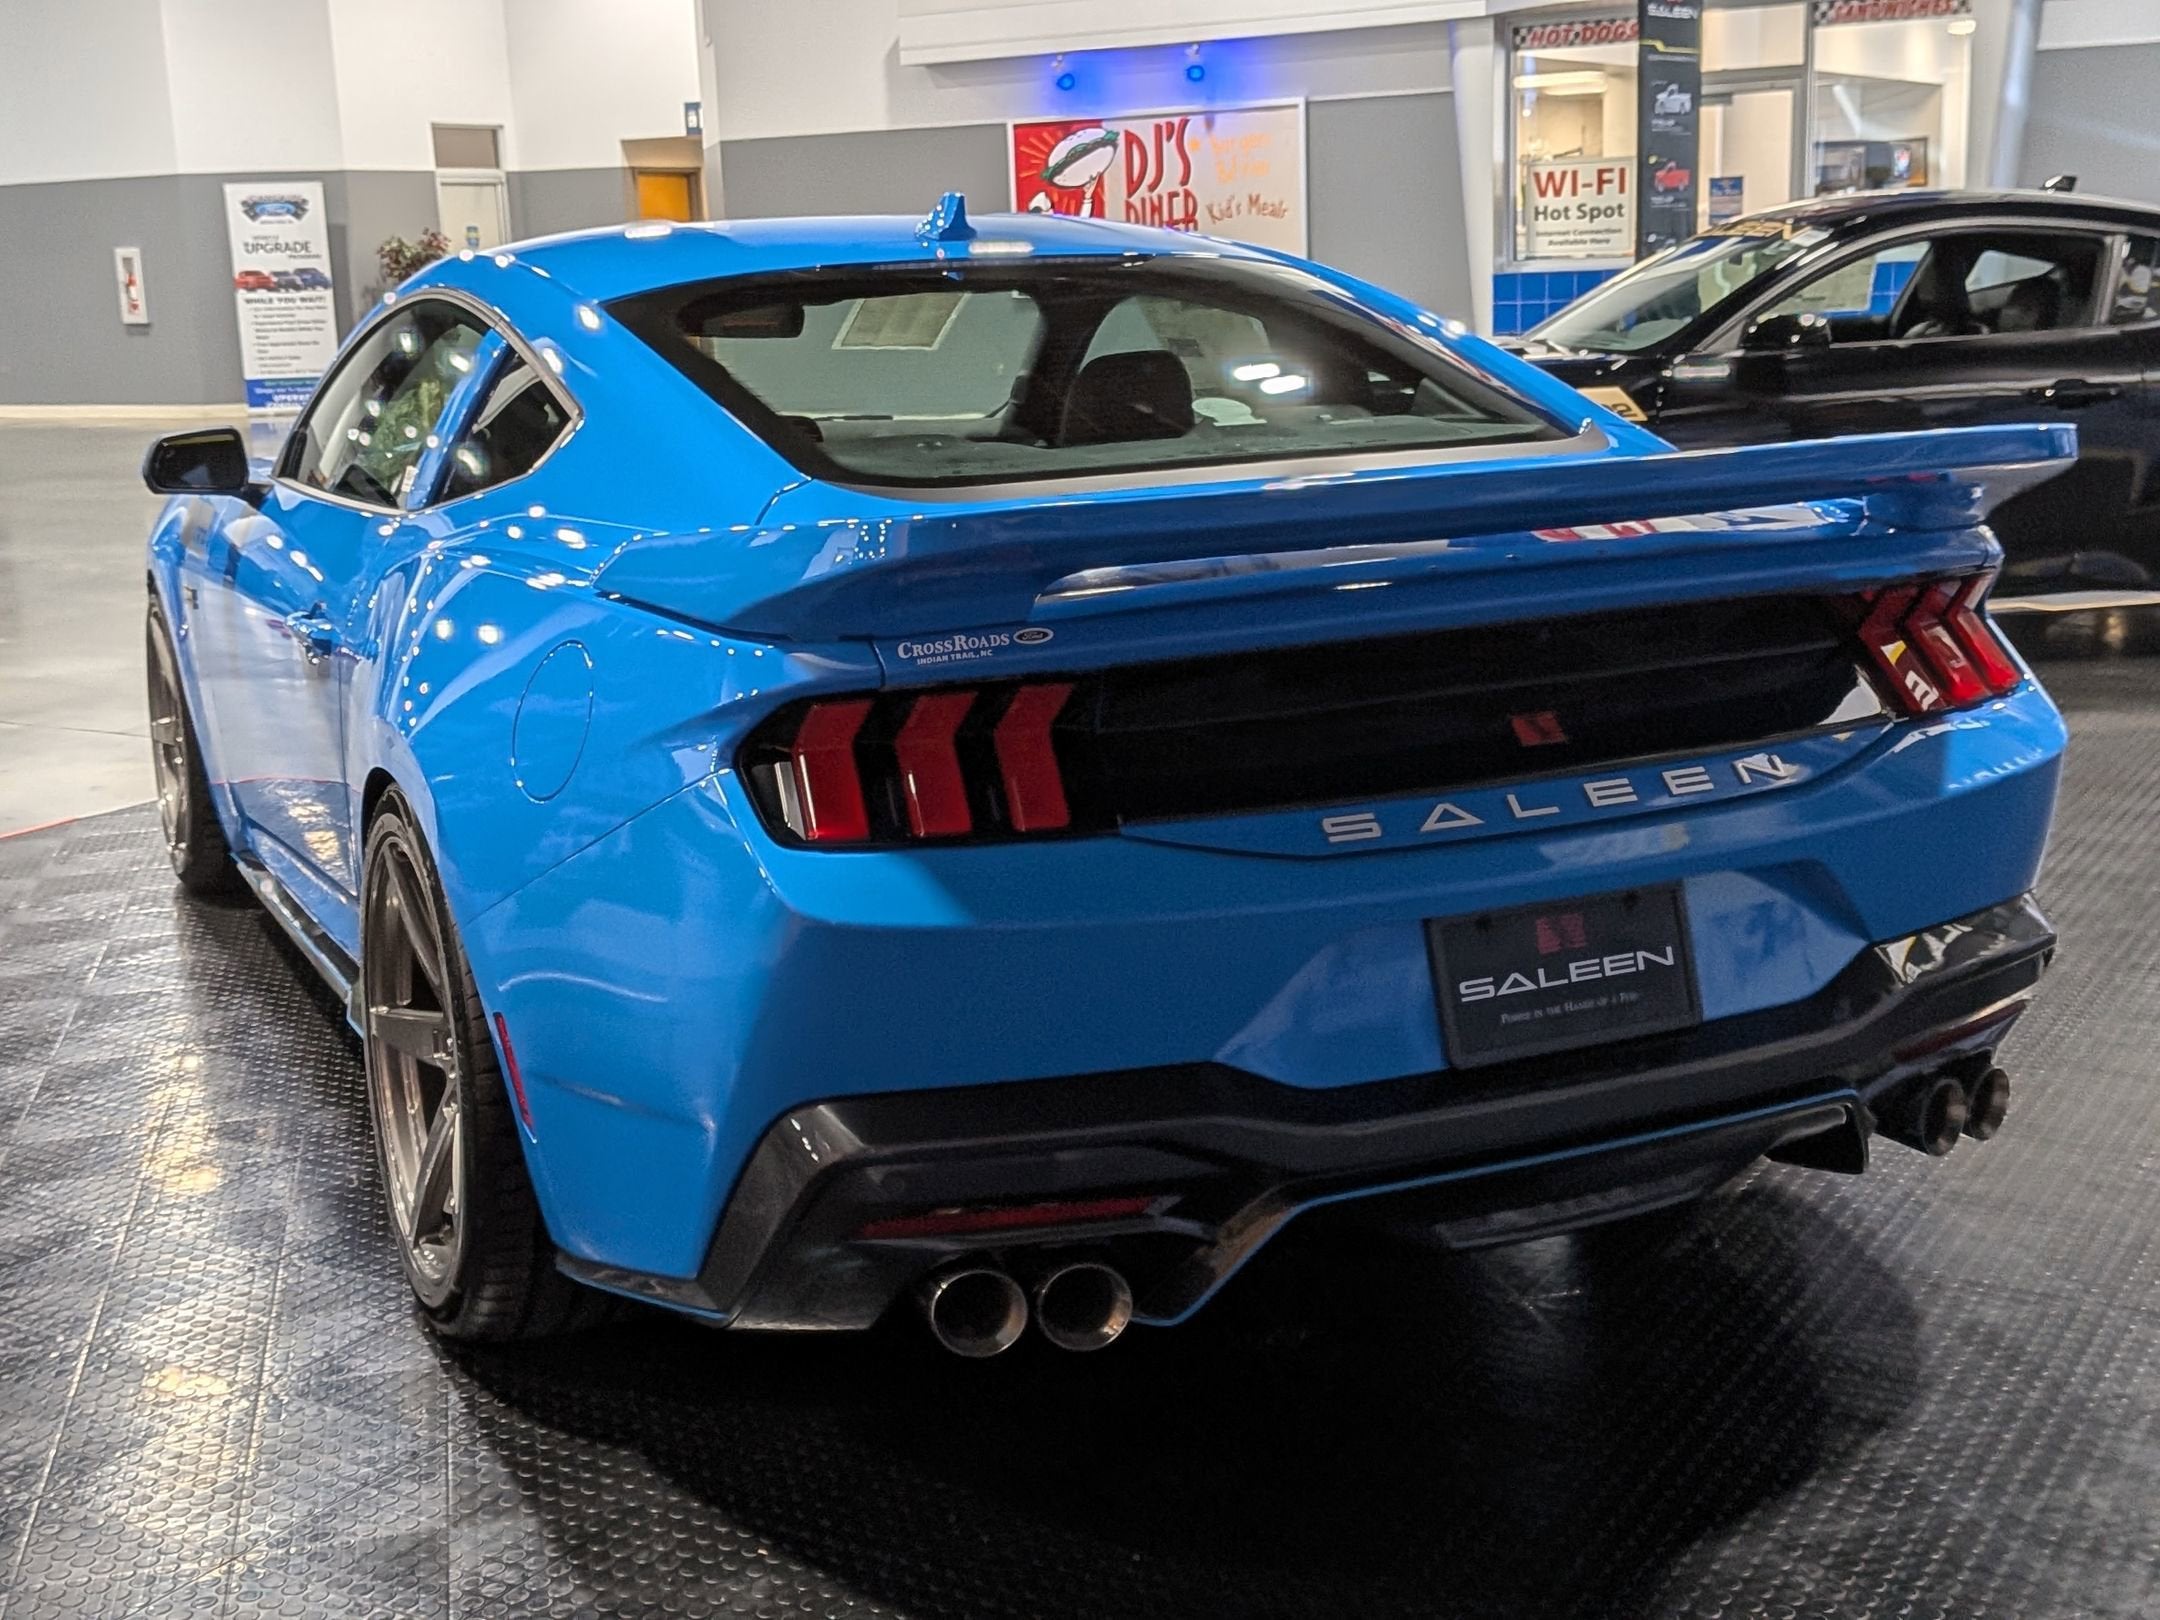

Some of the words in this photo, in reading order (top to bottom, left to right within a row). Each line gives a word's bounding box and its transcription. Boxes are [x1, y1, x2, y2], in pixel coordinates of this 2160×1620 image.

[1529, 27, 1574, 46] HOT
[1580, 19, 1639, 44] DOGS
[1124, 115, 1191, 199] DJ'S
[1533, 167, 1627, 199] WI-FI
[1125, 188, 1199, 232] DINER
[1205, 195, 1241, 224] Kid's
[1248, 193, 1288, 220] Meals
[1534, 206, 1571, 222] Hot
[1576, 203, 1625, 223] Spot
[244, 241, 312, 254] UPGRADE
[917, 654, 949, 665] INDIAN
[980, 649, 993, 658] NC
[1322, 753, 1795, 843] SALEEN
[1459, 945, 1675, 1002] SALEEN
